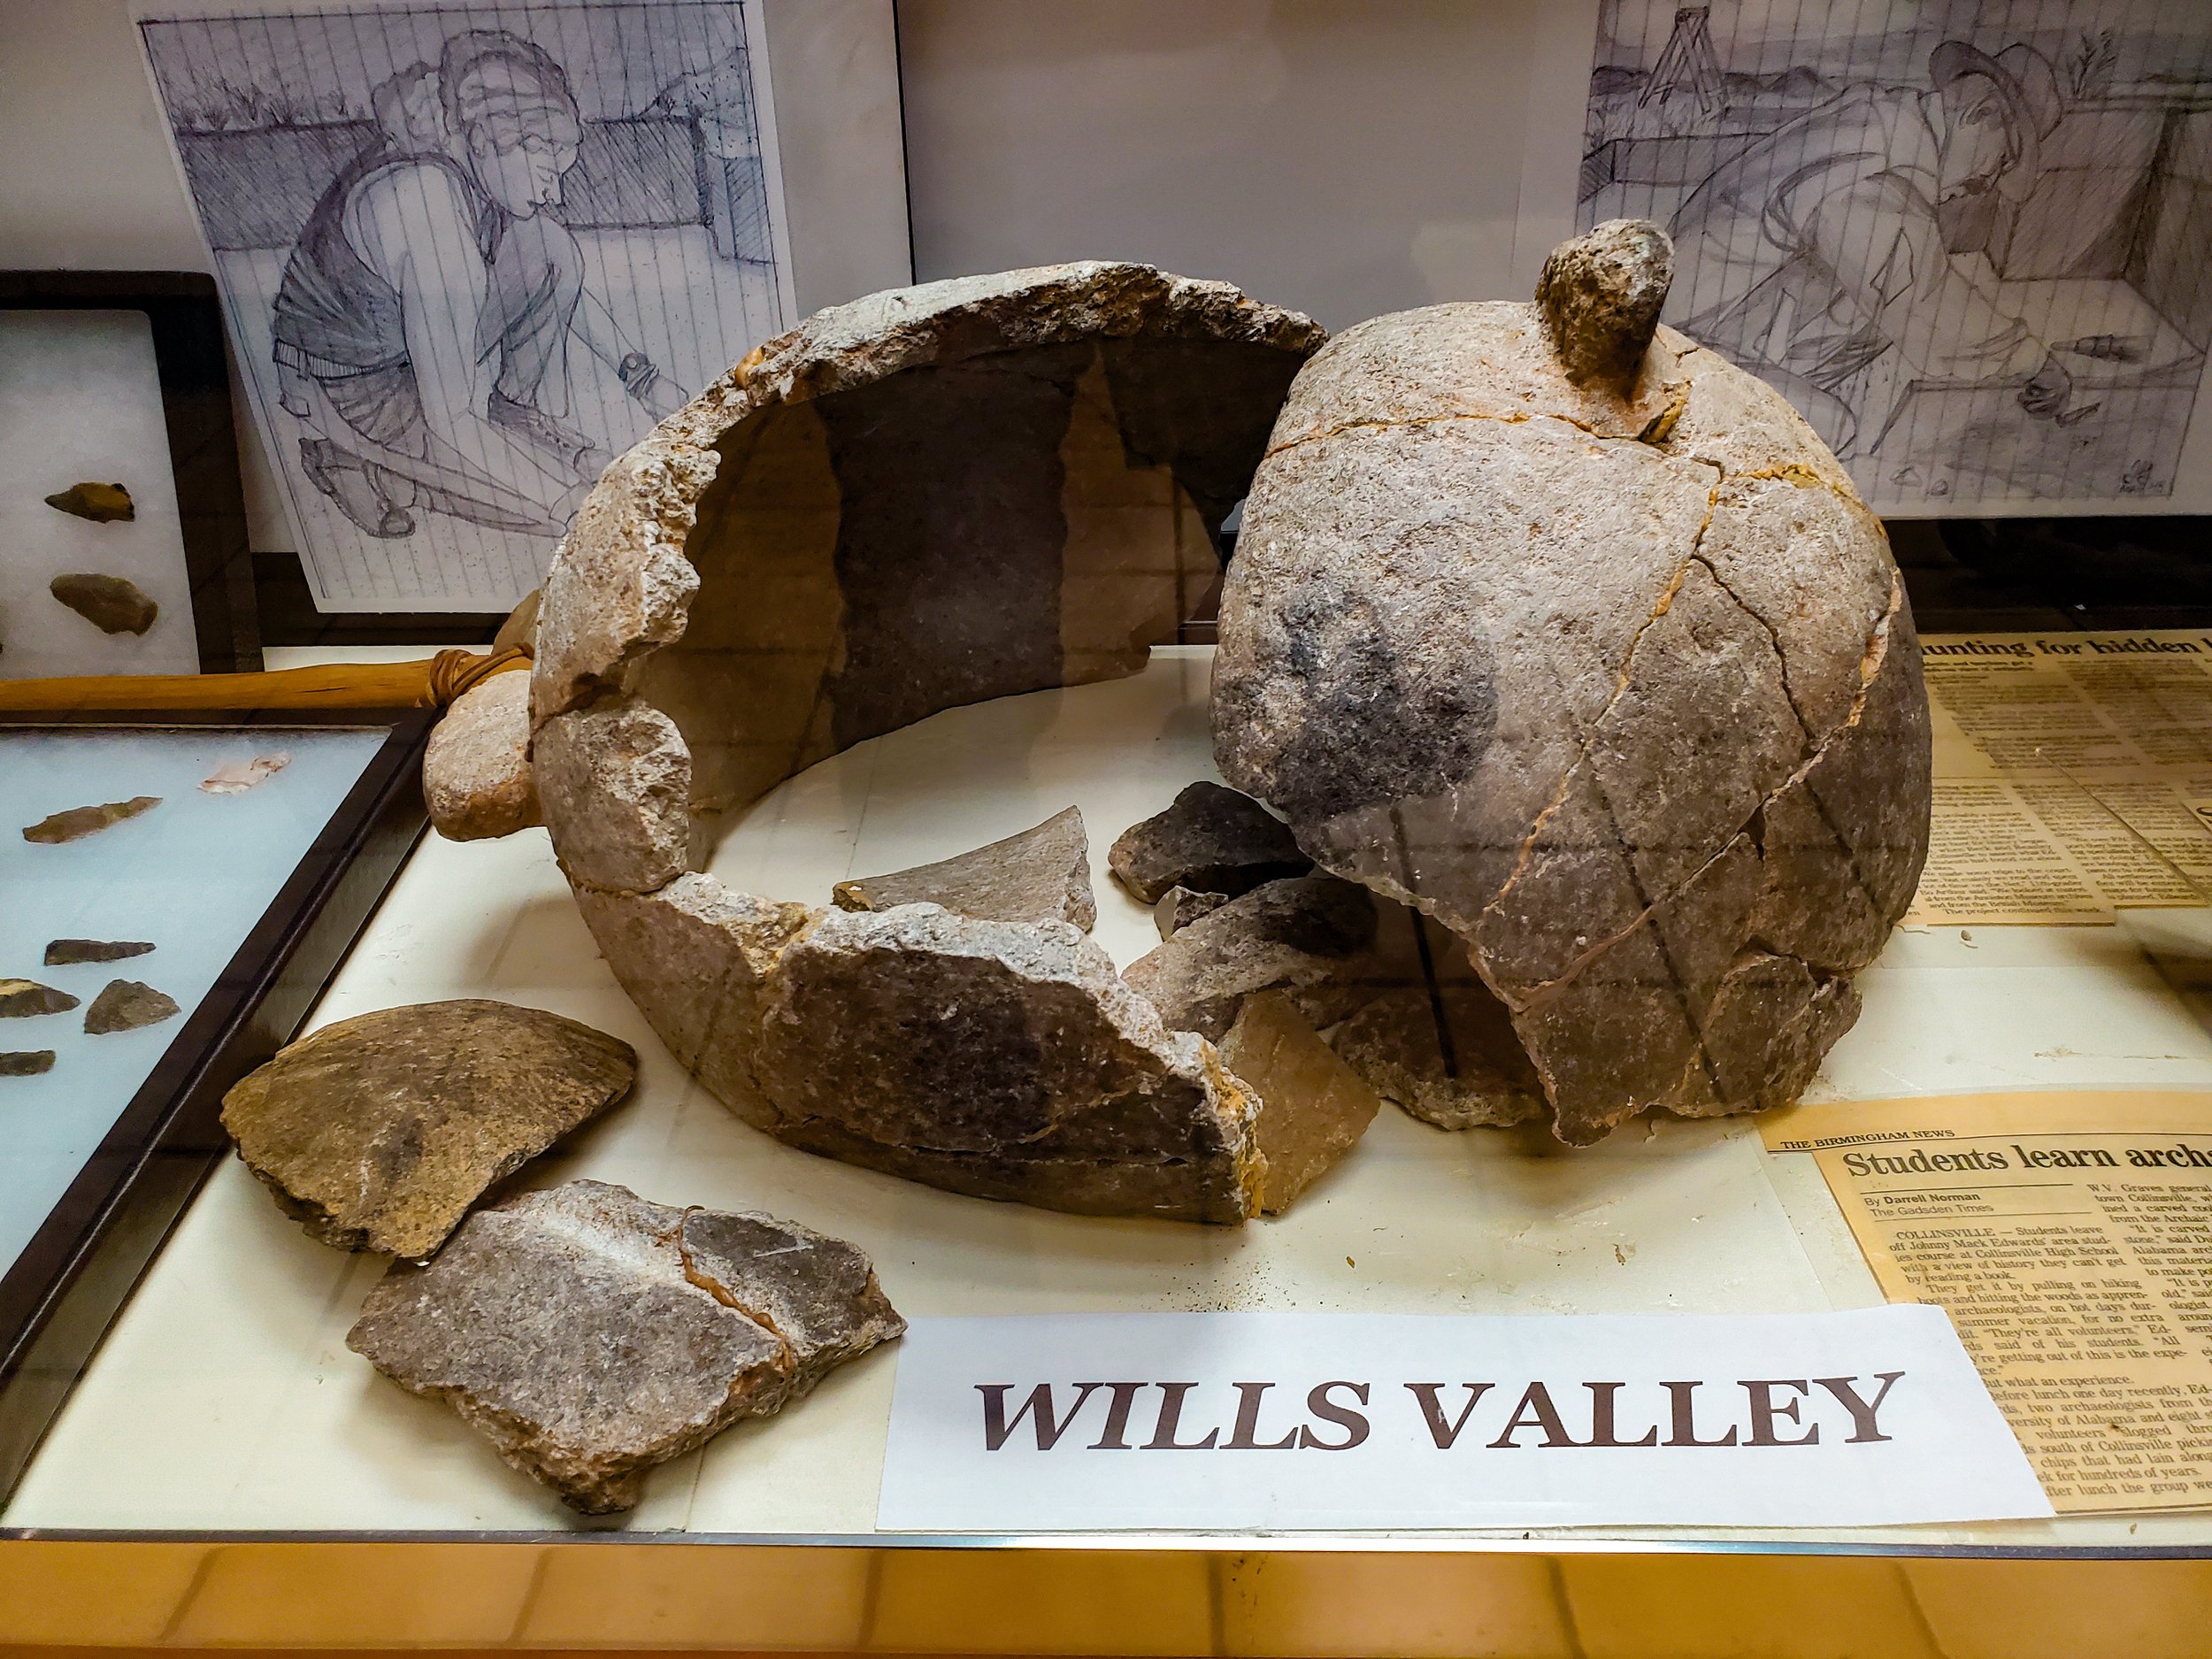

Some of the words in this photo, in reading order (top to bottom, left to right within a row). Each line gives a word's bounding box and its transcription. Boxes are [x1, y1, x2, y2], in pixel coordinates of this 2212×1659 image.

[2035, 640, 2082, 655] for
[2086, 638, 2202, 655] hidden
[1814, 1132, 1909, 1147] BIRMINGHAM
[1912, 1130, 1955, 1139] NEWS
[1843, 1148, 2008, 1177] Students
[2010, 1144, 2121, 1168] learn
[1884, 1194, 1927, 1204] Darrell
[1870, 1208, 1894, 1217] The
[1897, 1205, 1953, 1216] Gadsden
[2163, 1214, 2209, 1223] Archaic
[1896, 1228, 1996, 1240] COLLINSVILLE
[2016, 1225, 2069, 1236] Students
[2070, 1225, 2103, 1234] leave
[2166, 1235, 2193, 1244] said
[1889, 1241, 1906, 1252] off
[1909, 1239, 1950, 1251] Johnny
[1954, 1238, 1988, 1248] Mack
[2081, 1236, 2111, 1245] stud-
[2132, 1246, 2187, 1255] Alabama
[1916, 1251, 1955, 1261] course
[1960, 1249, 1973, 1259] at
[1976, 1248, 2043, 1258] Collinsville
[2045, 1248, 2076, 1258] High
[2078, 1246, 2119, 1256] School
[2138, 1256, 2163, 1265] this
[1901, 1263, 1928, 1273] with
[1944, 1262, 1972, 1271] view
[1978, 1260, 1991, 1269] of
[1994, 1258, 2035, 1270] history
[2039, 1258, 2067, 1269] they
[2072, 1256, 2103, 1267] can't
[2106, 1257, 2127, 1268] get
[2161, 1267, 2195, 1276] make
[1905, 1274, 1922, 1285] by
[1925, 1272, 1973, 1283] reading
[2188, 1278, 2200, 1286] is
[1925, 1284, 1957, 1294] They
[1966, 1283, 1986, 1293] get
[1991, 1282, 2002, 1291] it
[2008, 1281, 2024, 1292] by
[2032, 1279, 2076, 1292] pulling
[2101, 1279, 2142, 1290] hiking
[1917, 1295, 1950, 1305] boots
[1954, 1294, 1977, 1304] and
[1978, 1293, 2021, 1304] hitting
[2021, 1292, 2042, 1302] the
[2045, 1291, 2082, 1301] woods
[2101, 1289, 2148, 1302] appren-
[1955, 1304, 2047, 1316] archaeologists,
[2069, 1302, 2091, 1311] hot
[2095, 1302, 2126, 1312] days
[2130, 1301, 2156, 1310] dur-
[1957, 1317, 2010, 1327] summer
[2017, 1315, 2076, 1326] vacation,
[2082, 1314, 2100, 1324] for
[2131, 1313, 2165, 1322] extra
[2045, 1326, 2062, 1337] all
[2147, 1324, 2171, 1334] Ed-
[1993, 1340, 2021, 1350] said
[2032, 1339, 2046, 1349] of
[2055, 1339, 2077, 1348] his
[1999, 1352, 2046, 1364] getting
[2047, 1351, 2069, 1362] out
[2070, 1351, 2084, 1360] of
[2085, 1349, 2112, 1360] this
[2113, 1349, 2126, 1359] is
[2128, 1348, 2151, 1358] the
[2153, 1348, 2188, 1360] expe-
[2005, 1377, 2039, 1387] what
[2040, 1378, 2058, 1386] an
[2032, 1388, 2070, 1400] lunch
[2072, 1389, 2096, 1399] one
[2099, 1387, 2123, 1400] day
[973, 1380, 1371, 1450] WILLS
[1404, 1371, 1906, 1448] VALLEY
[2027, 1402, 2054, 1413] two
[2060, 1400, 2154, 1413] archaeologists
[2159, 1398, 2194, 1409] from
[2057, 1415, 2072, 1425] of
[2076, 1414, 2137, 1425] Alabama
[2139, 1412, 2166, 1423] and
[2168, 1410, 2202, 1423] eight
[2035, 1428, 2108, 1440] volunteers
[2120, 1425, 2172, 1439] slogged
[2039, 1441, 2078, 1454] south
[2080, 1440, 2095, 1452] of
[2098, 1439, 2173, 1452] Collinsville
[2040, 1455, 2078, 1470] chips
[2081, 1455, 2111, 1466] that
[2114, 1453, 2143, 1465] had
[2146, 1452, 2175, 1464] lain
[2055, 1471, 2076, 1482] for
[2077, 1468, 2143, 1481] hundreds
[2144, 1467, 2159, 1479] of
[2077, 1483, 2117, 1495] lunch
[2121, 1482, 2146, 1494] the
[2150, 1481, 2189, 1495] group
